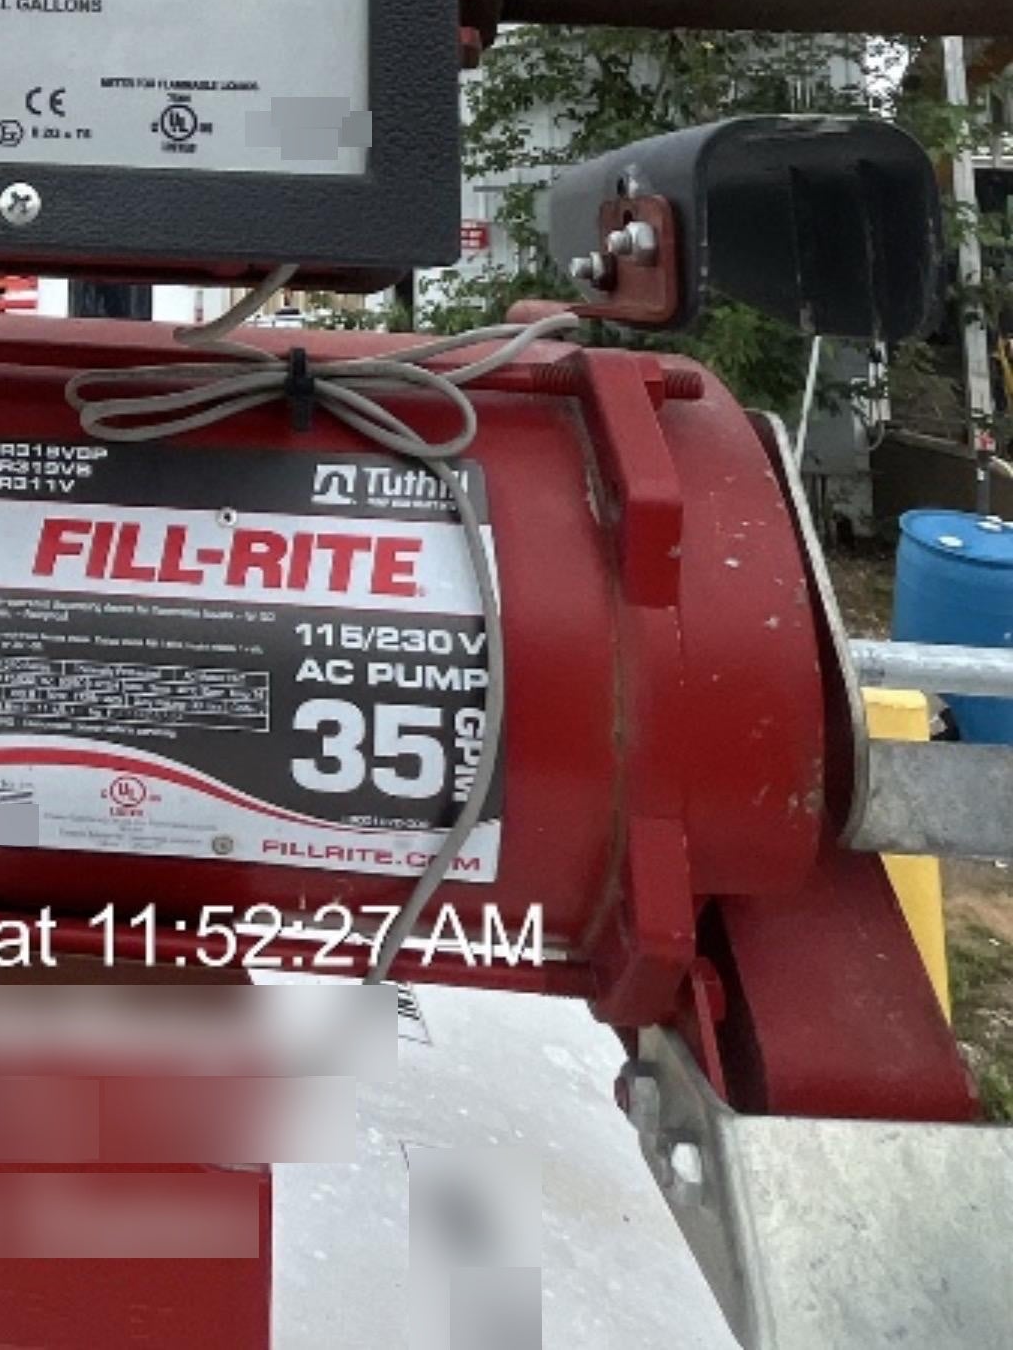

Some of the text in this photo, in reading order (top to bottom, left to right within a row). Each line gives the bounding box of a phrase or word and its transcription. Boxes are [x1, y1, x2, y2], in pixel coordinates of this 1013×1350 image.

[30, 517, 426, 598] FILL-RITE
[294, 622, 453, 656] 115/230
[458, 632, 487, 655] V
[295, 657, 489, 692] AC PUMP
[291, 698, 447, 799] 35
